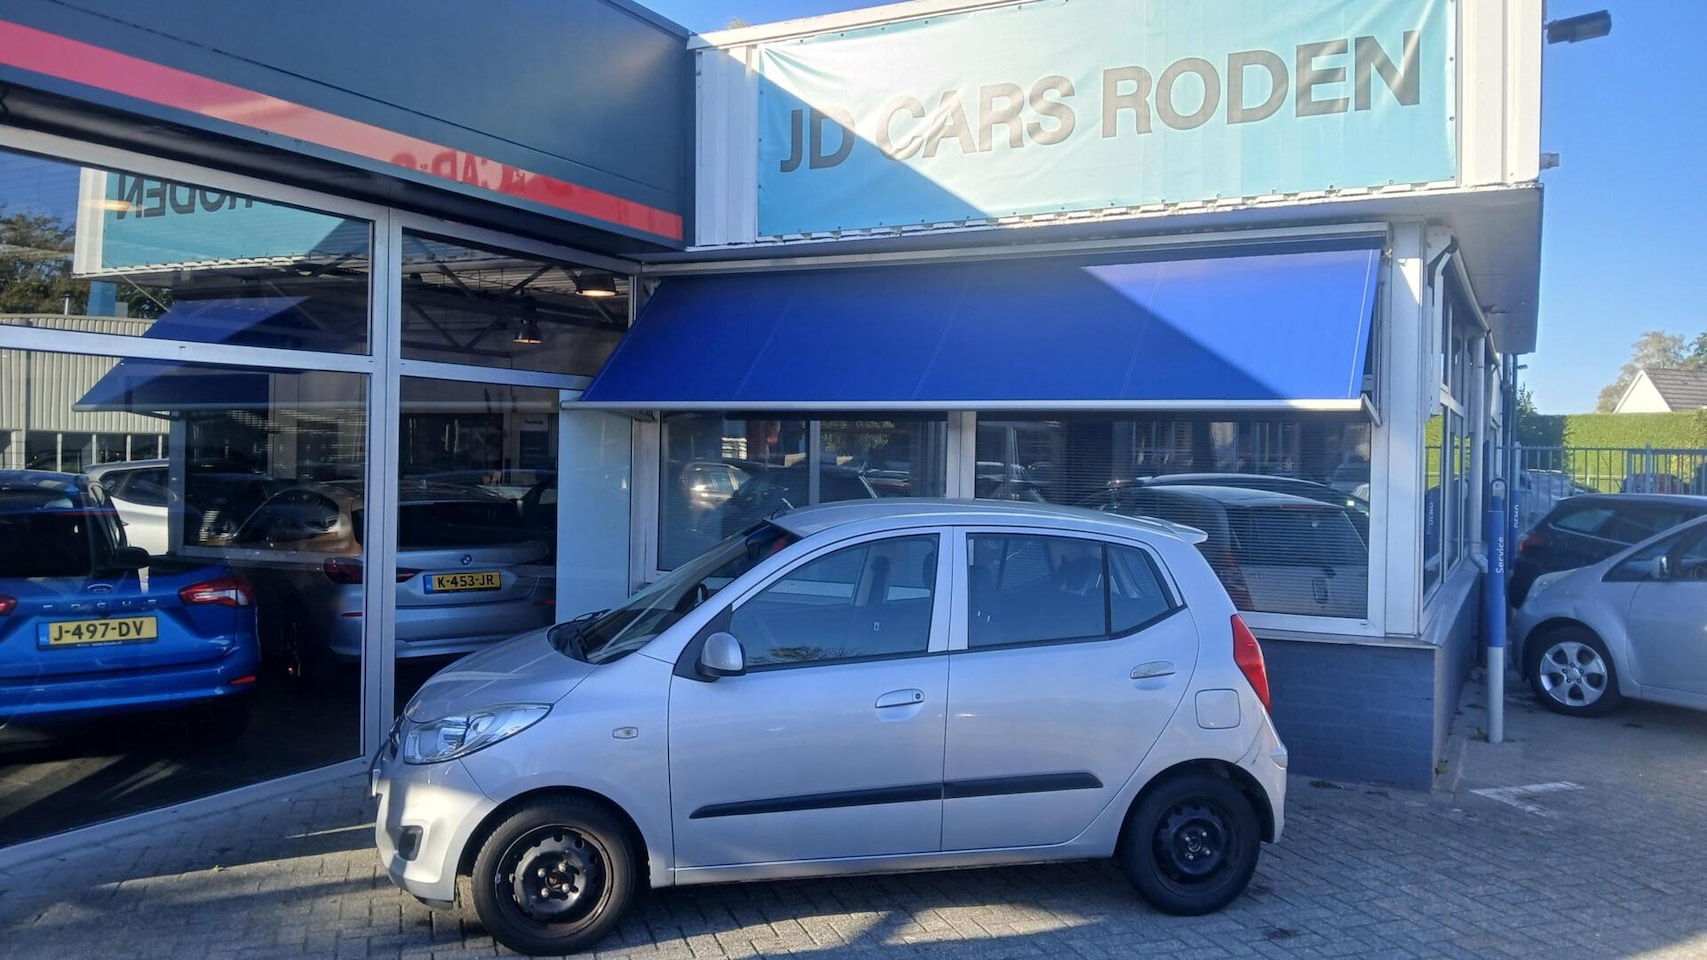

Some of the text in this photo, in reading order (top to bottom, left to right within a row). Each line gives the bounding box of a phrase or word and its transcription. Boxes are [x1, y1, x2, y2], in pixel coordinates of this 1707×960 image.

[780, 29, 1421, 172] JD CARS RODEN
[1495, 536, 1505, 574] Service
[437, 574, 495, 589] K-453-JR
[53, 620, 145, 642] J-497-DV
